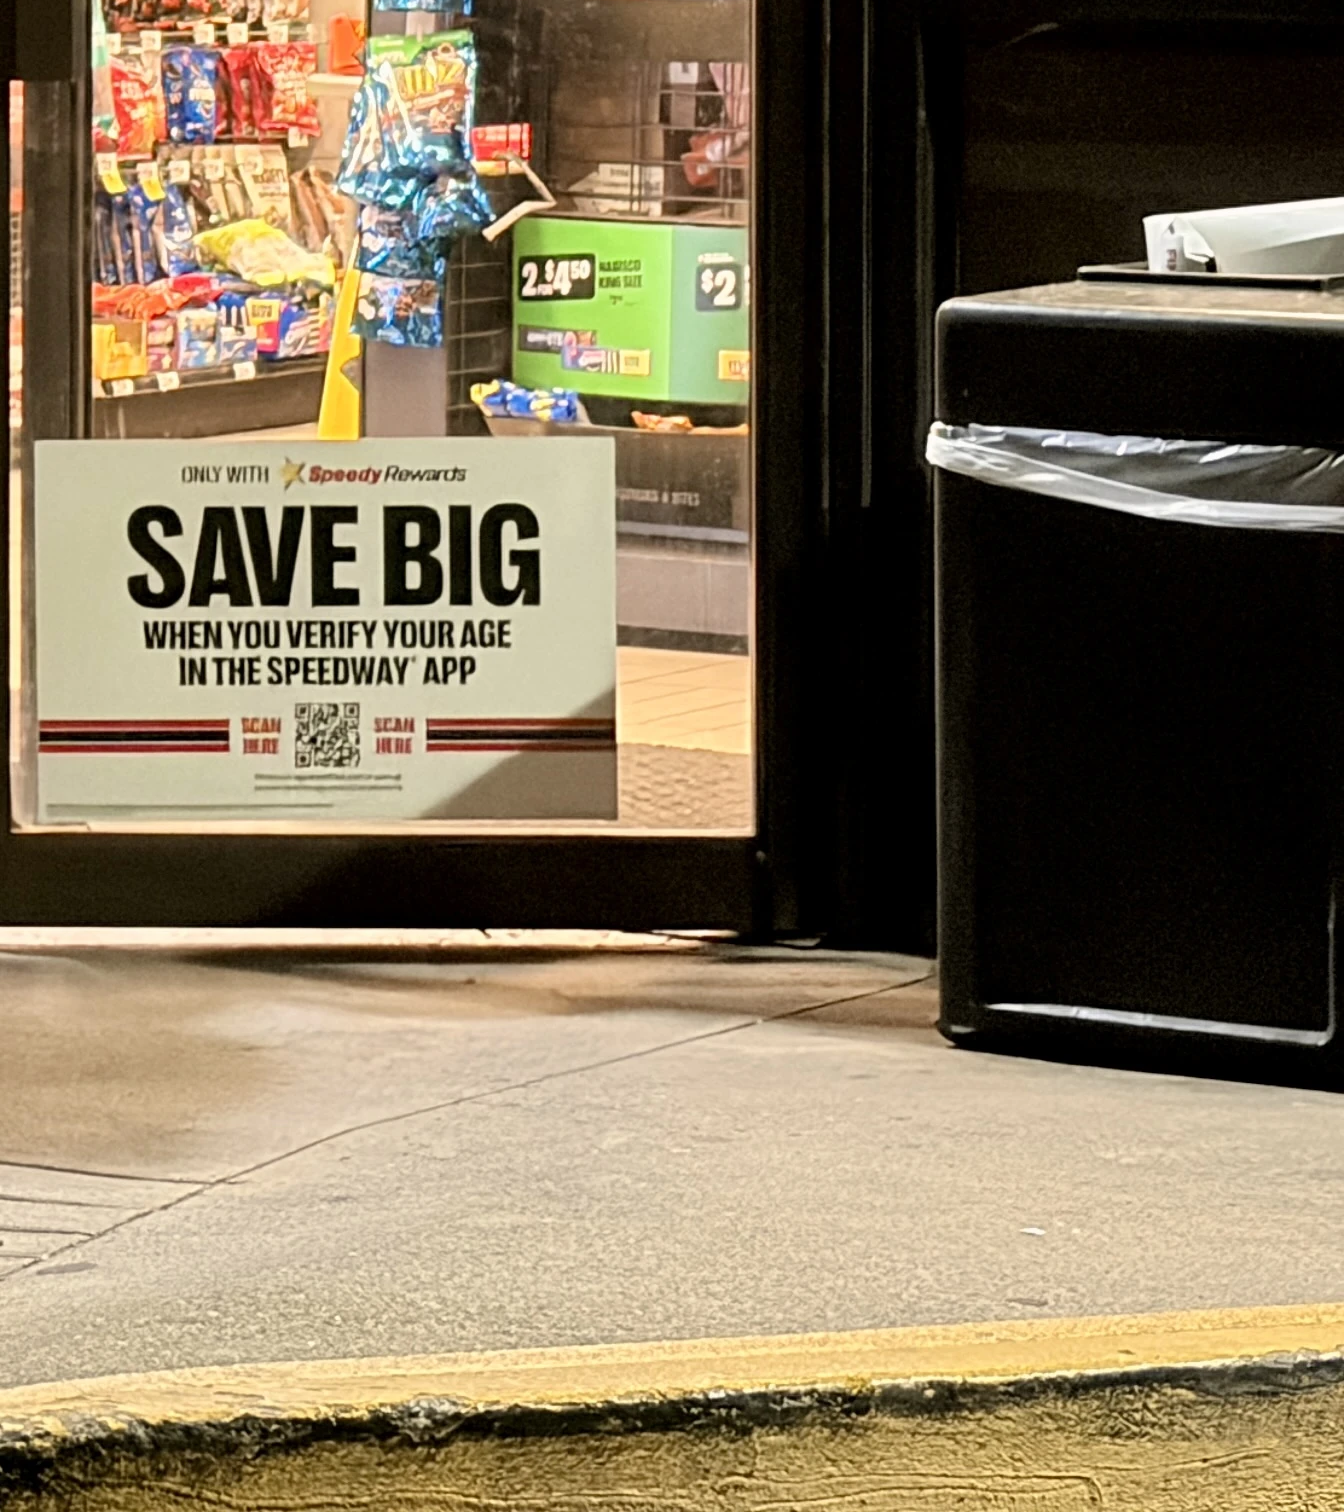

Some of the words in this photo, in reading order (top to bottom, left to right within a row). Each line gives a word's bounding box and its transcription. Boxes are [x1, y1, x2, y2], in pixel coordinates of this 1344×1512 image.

[599, 275, 622, 288] KING
[182, 465, 223, 485] ONLY
[227, 465, 269, 484] WITH
[308, 464, 381, 485] Speedy
[384, 464, 468, 484] Rewards
[127, 504, 360, 609] SAVE
[383, 502, 542, 608] BIG
[144, 620, 222, 650] WHEN
[228, 620, 282, 650] YOU
[286, 619, 378, 649] VERIFY
[383, 619, 456, 649] YOUR
[460, 619, 512, 649] AGE
[179, 656, 211, 686] IN
[213, 656, 262, 686] THE
[422, 656, 477, 686] APP
[241, 717, 281, 733] SCAN
[374, 717, 414, 733] SCAN
[243, 738, 279, 754] HERE
[376, 738, 412, 754] HERE
